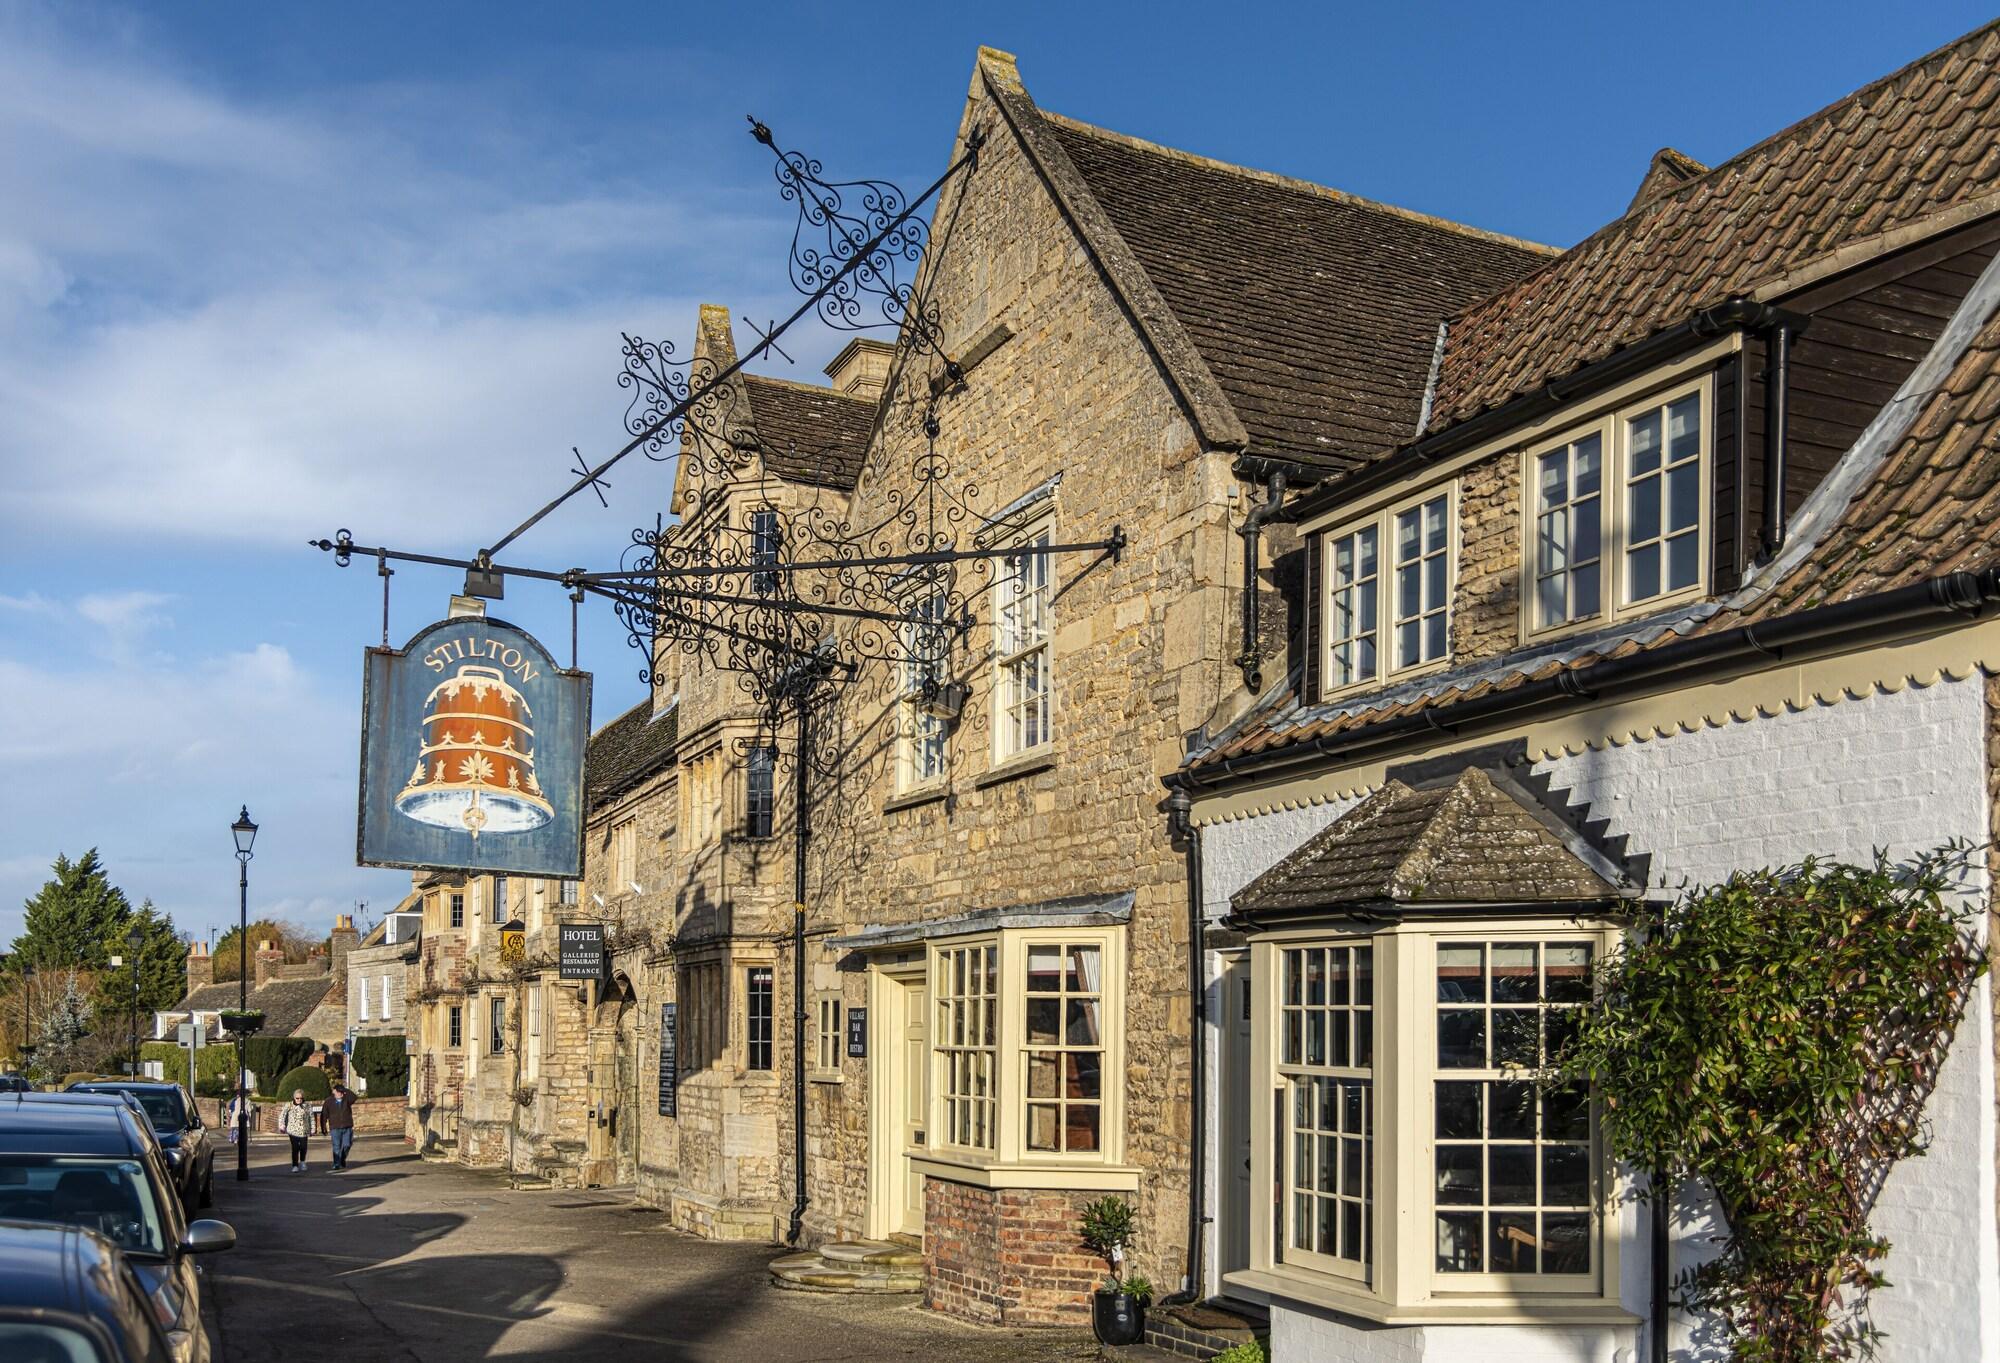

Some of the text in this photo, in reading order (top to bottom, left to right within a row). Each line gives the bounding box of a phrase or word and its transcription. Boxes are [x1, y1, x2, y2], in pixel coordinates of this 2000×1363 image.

[424, 637, 539, 683] STILTON
[564, 930, 600, 941] HOTEL
[849, 1011, 864, 1020] VILLAGE
[852, 1023, 861, 1032] BAR
